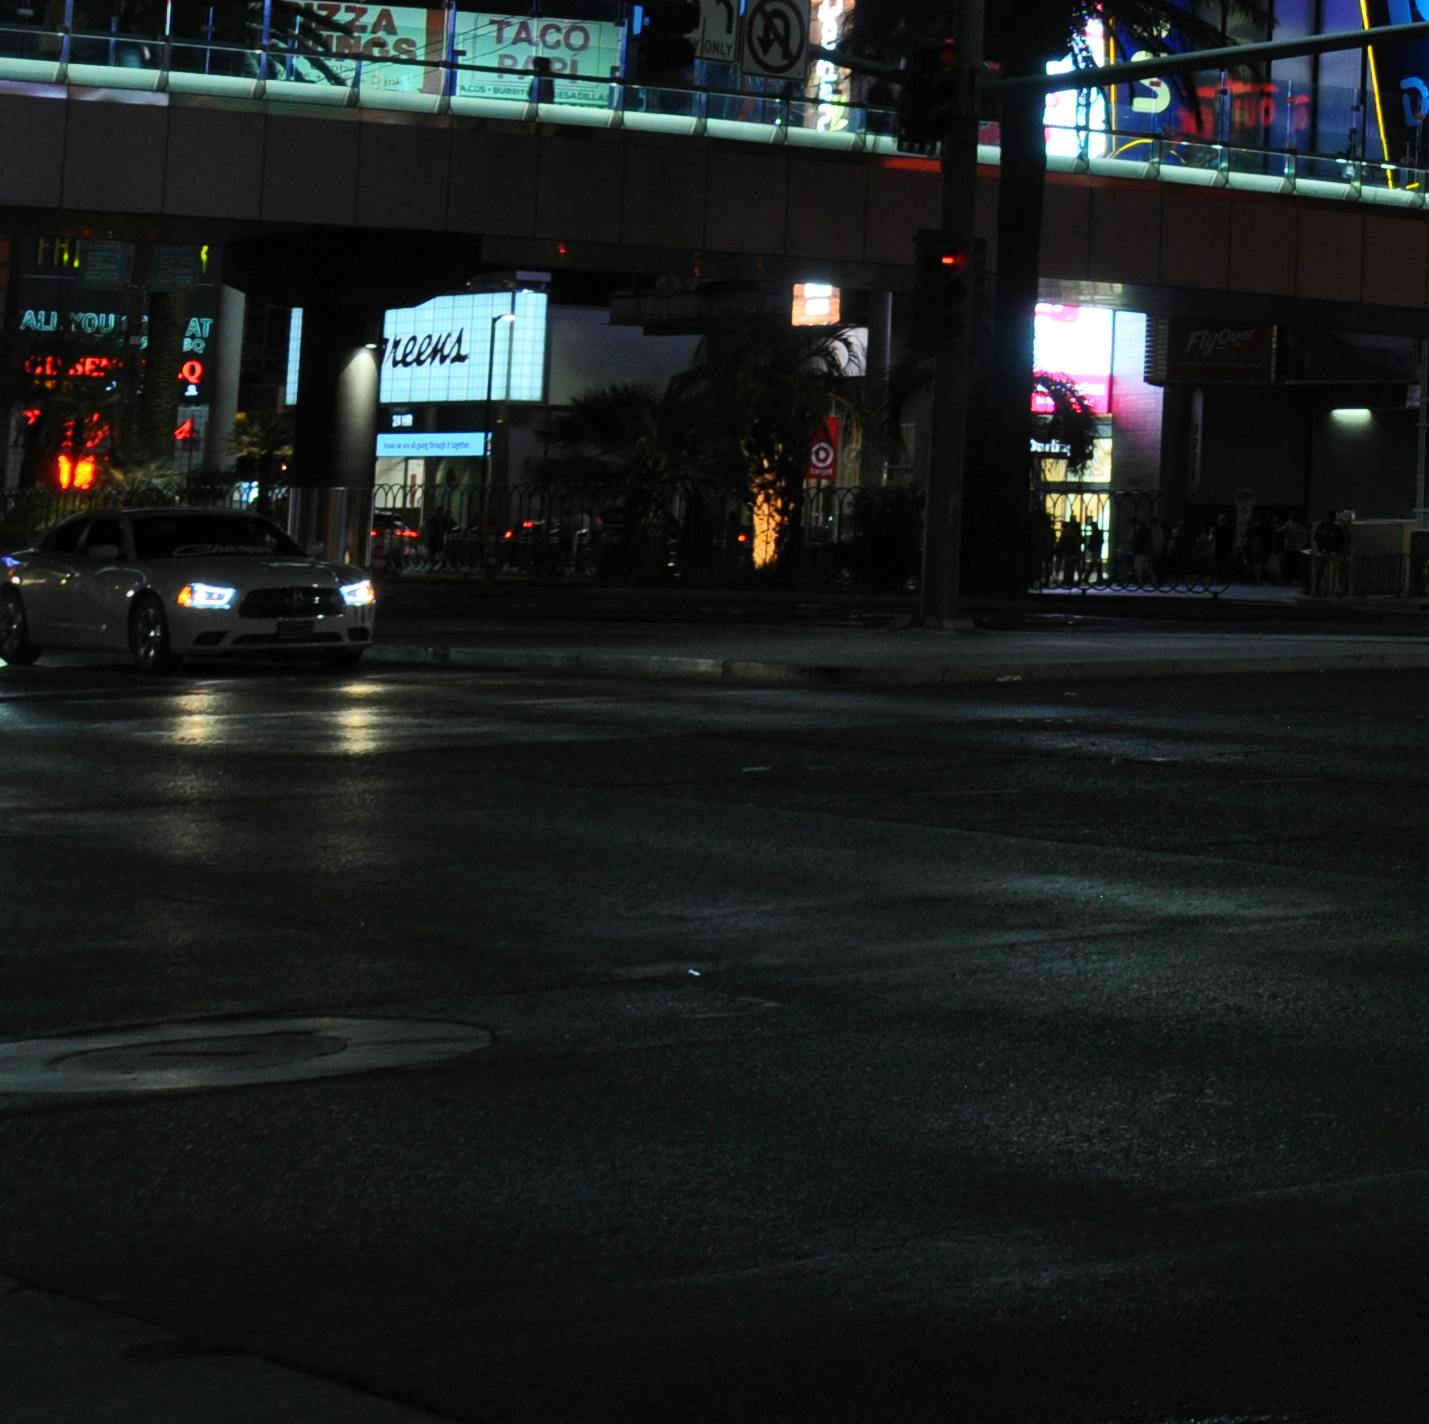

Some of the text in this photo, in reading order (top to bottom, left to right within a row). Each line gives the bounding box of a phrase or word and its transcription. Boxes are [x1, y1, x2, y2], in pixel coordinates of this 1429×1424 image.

[299, 34, 418, 61] INGS
[704, 40, 734, 56] ONLY
[382, 327, 470, 369] reens
